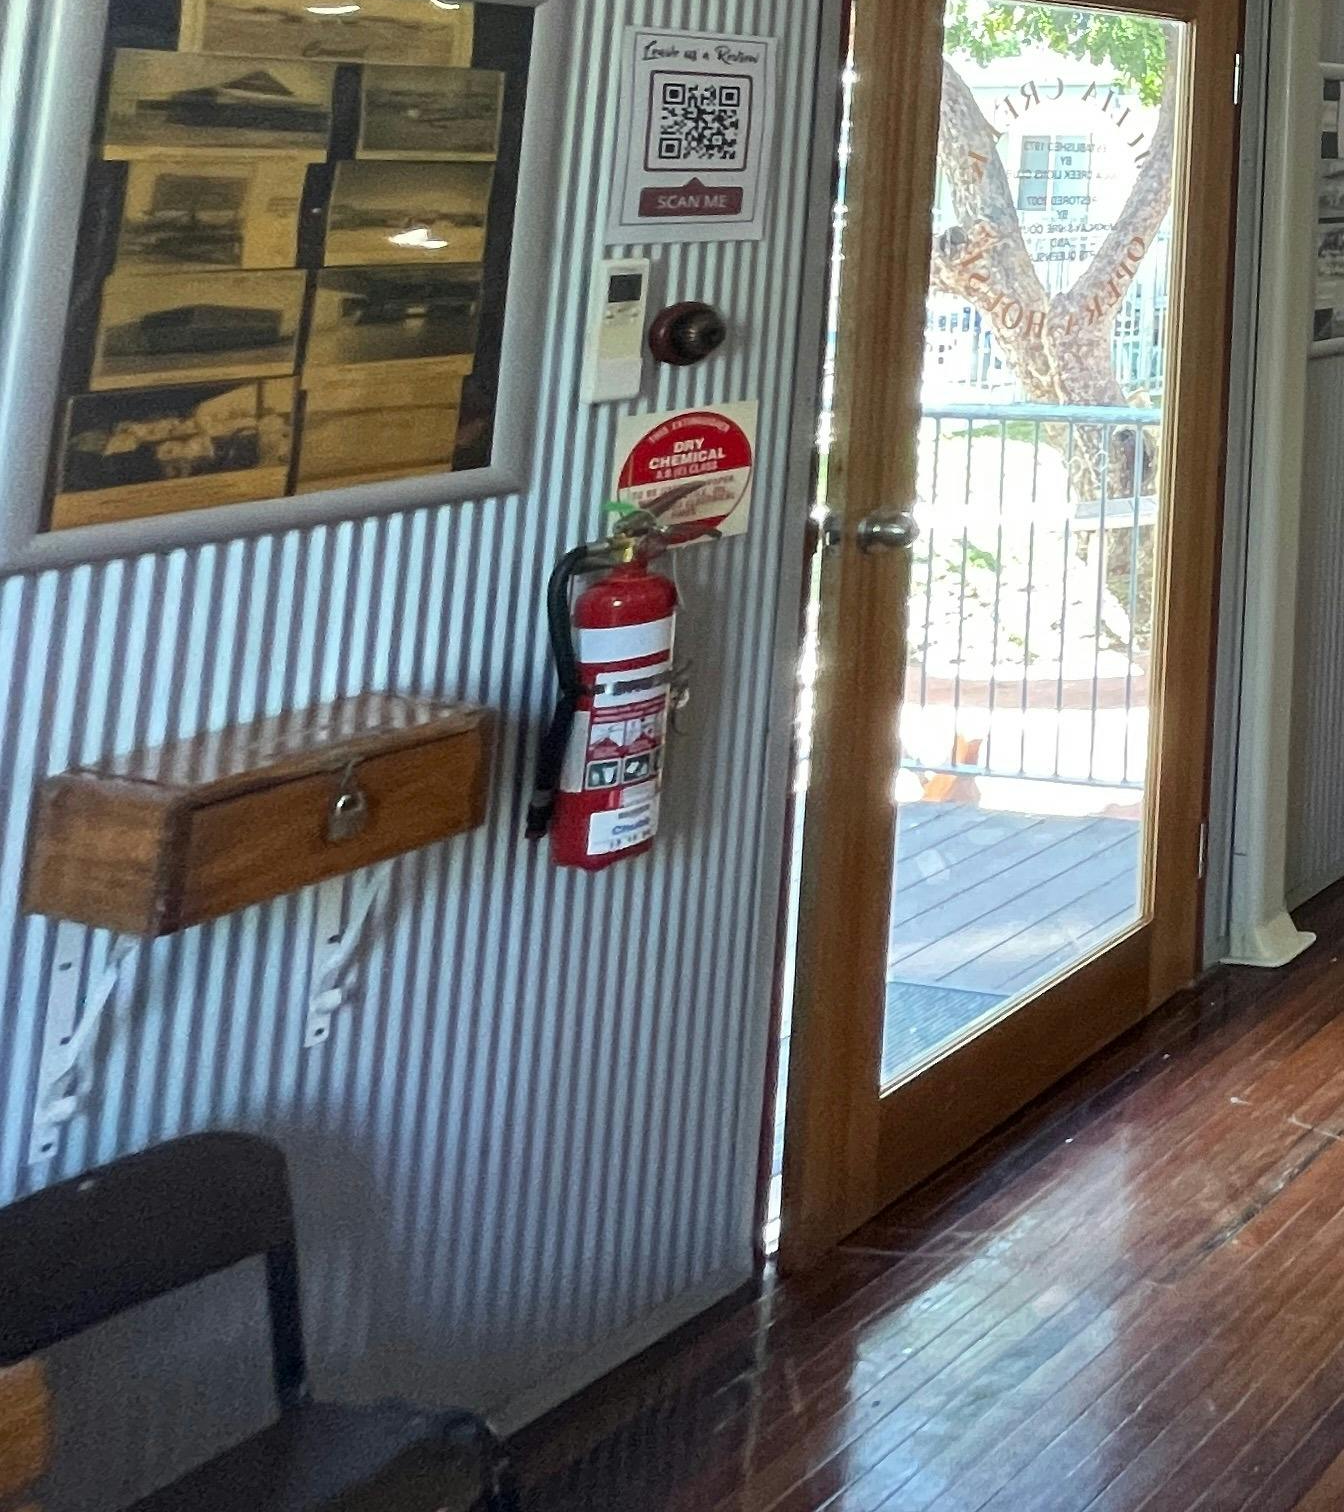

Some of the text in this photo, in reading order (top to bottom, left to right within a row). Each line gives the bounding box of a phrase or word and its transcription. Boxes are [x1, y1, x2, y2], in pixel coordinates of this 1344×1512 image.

[642, 39, 680, 61] Leave
[714, 45, 760, 65] Review
[657, 195, 729, 209] SCAN ME
[673, 437, 705, 453] DRY
[649, 447, 727, 470] CHEMICAL
